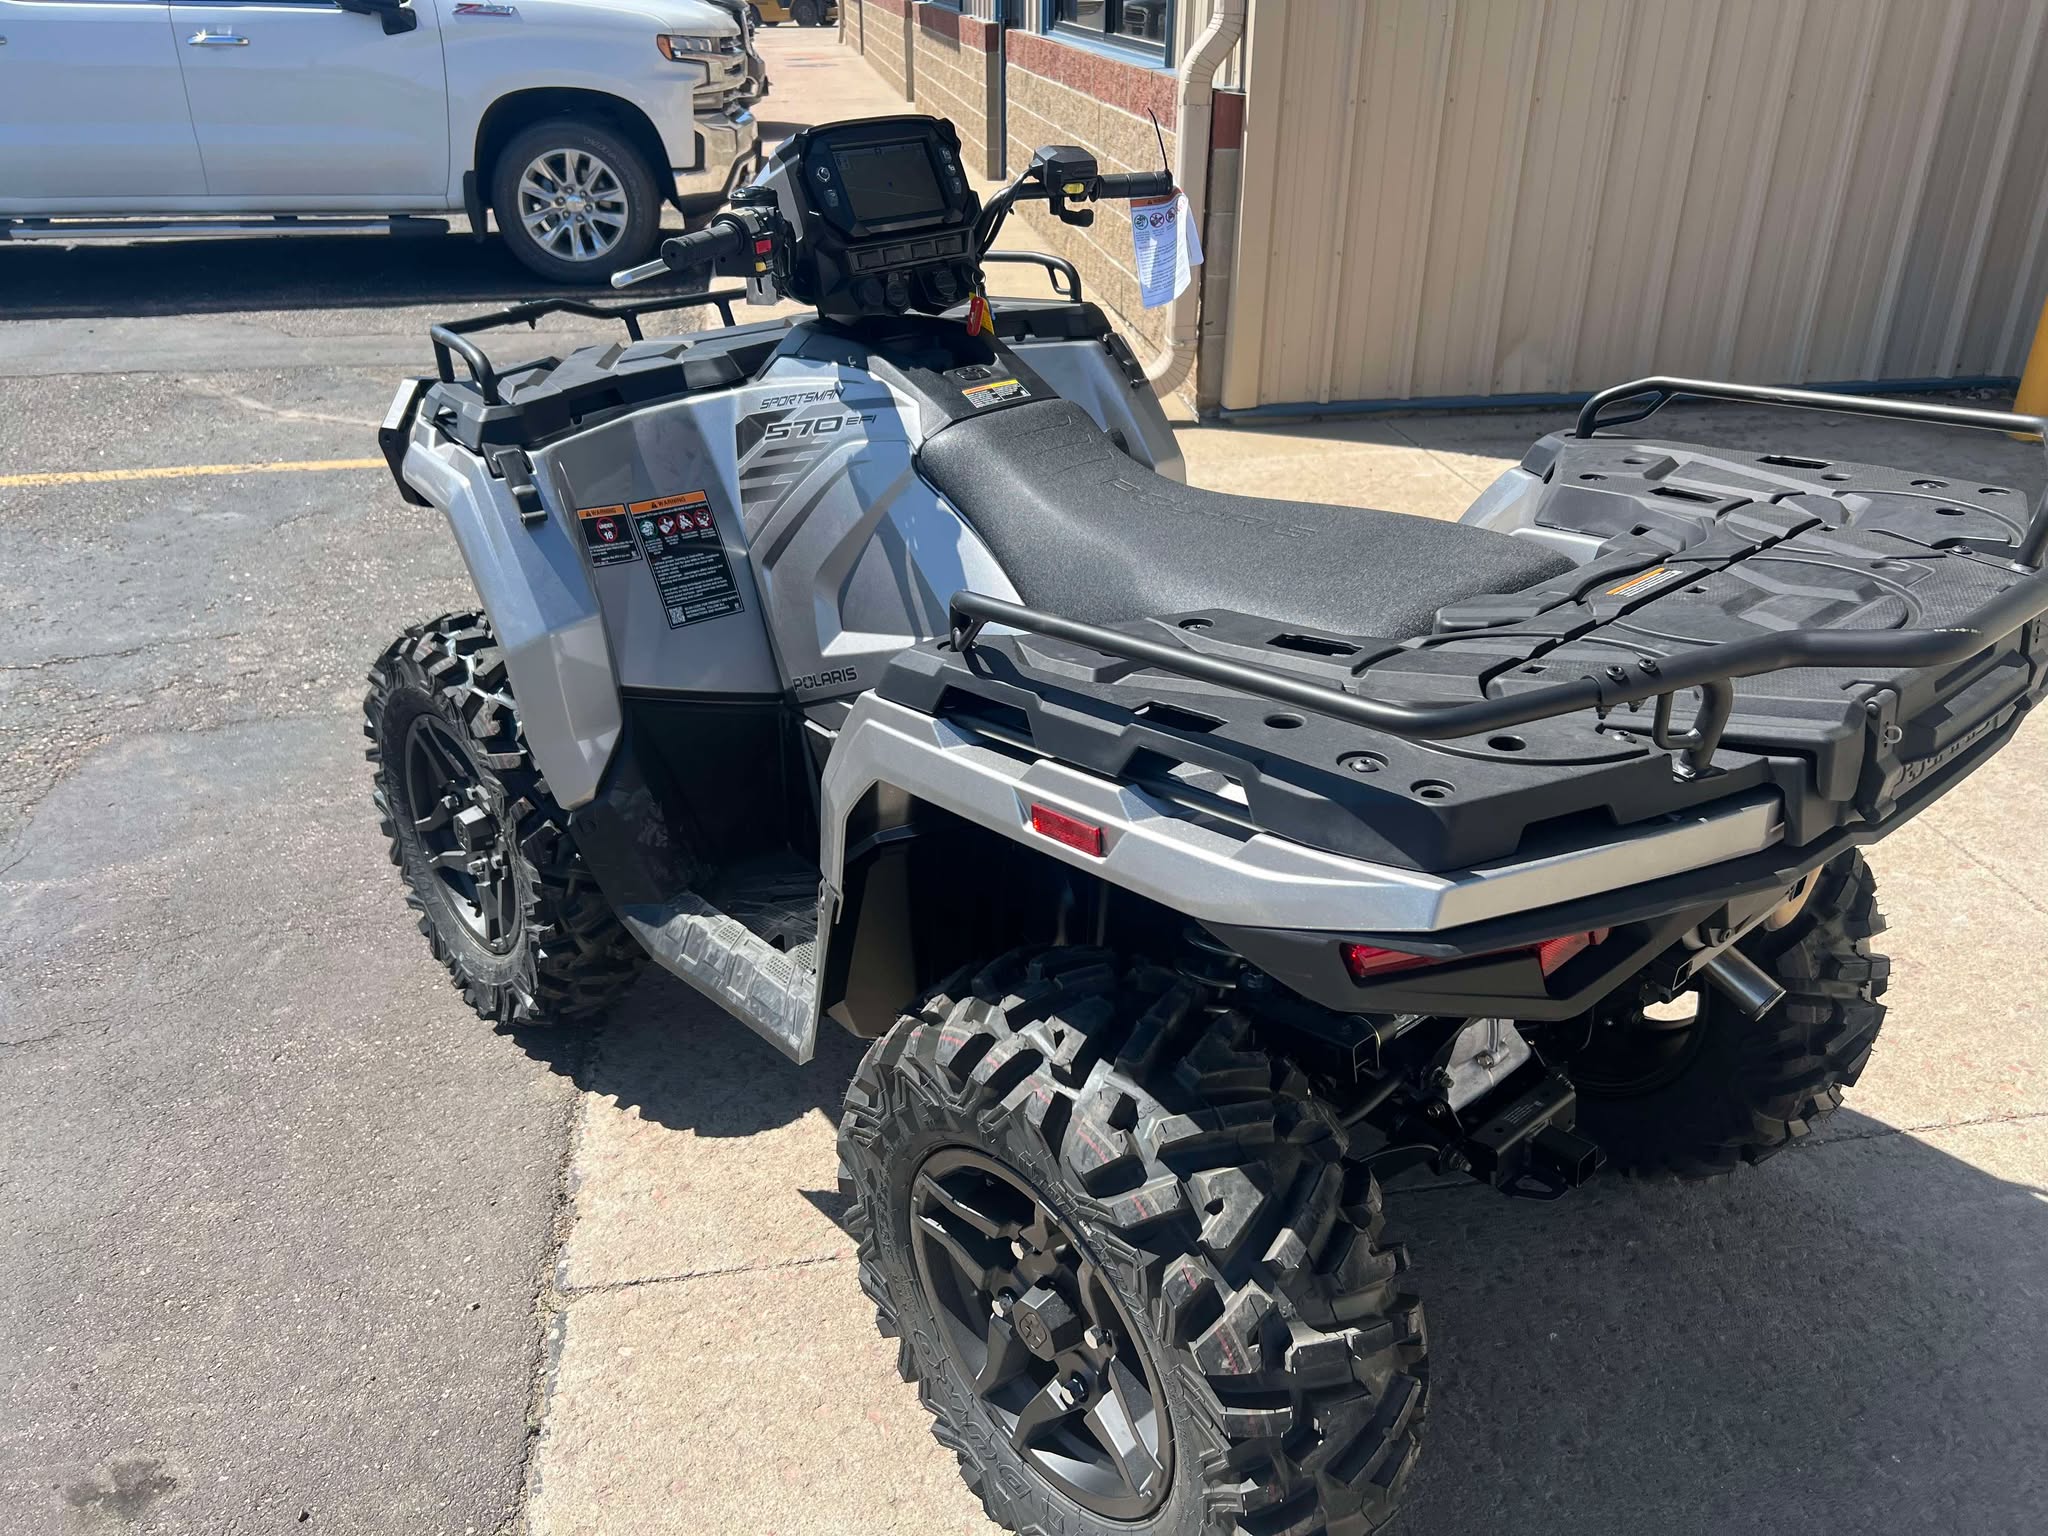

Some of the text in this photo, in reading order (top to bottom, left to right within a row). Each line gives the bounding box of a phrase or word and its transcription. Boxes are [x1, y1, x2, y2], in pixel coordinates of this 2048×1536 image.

[760, 387, 845, 409] SPORTSMAN
[765, 415, 877, 441] 570 EFI
[658, 496, 686, 507] WARNING
[792, 666, 858, 691] POLARIS
